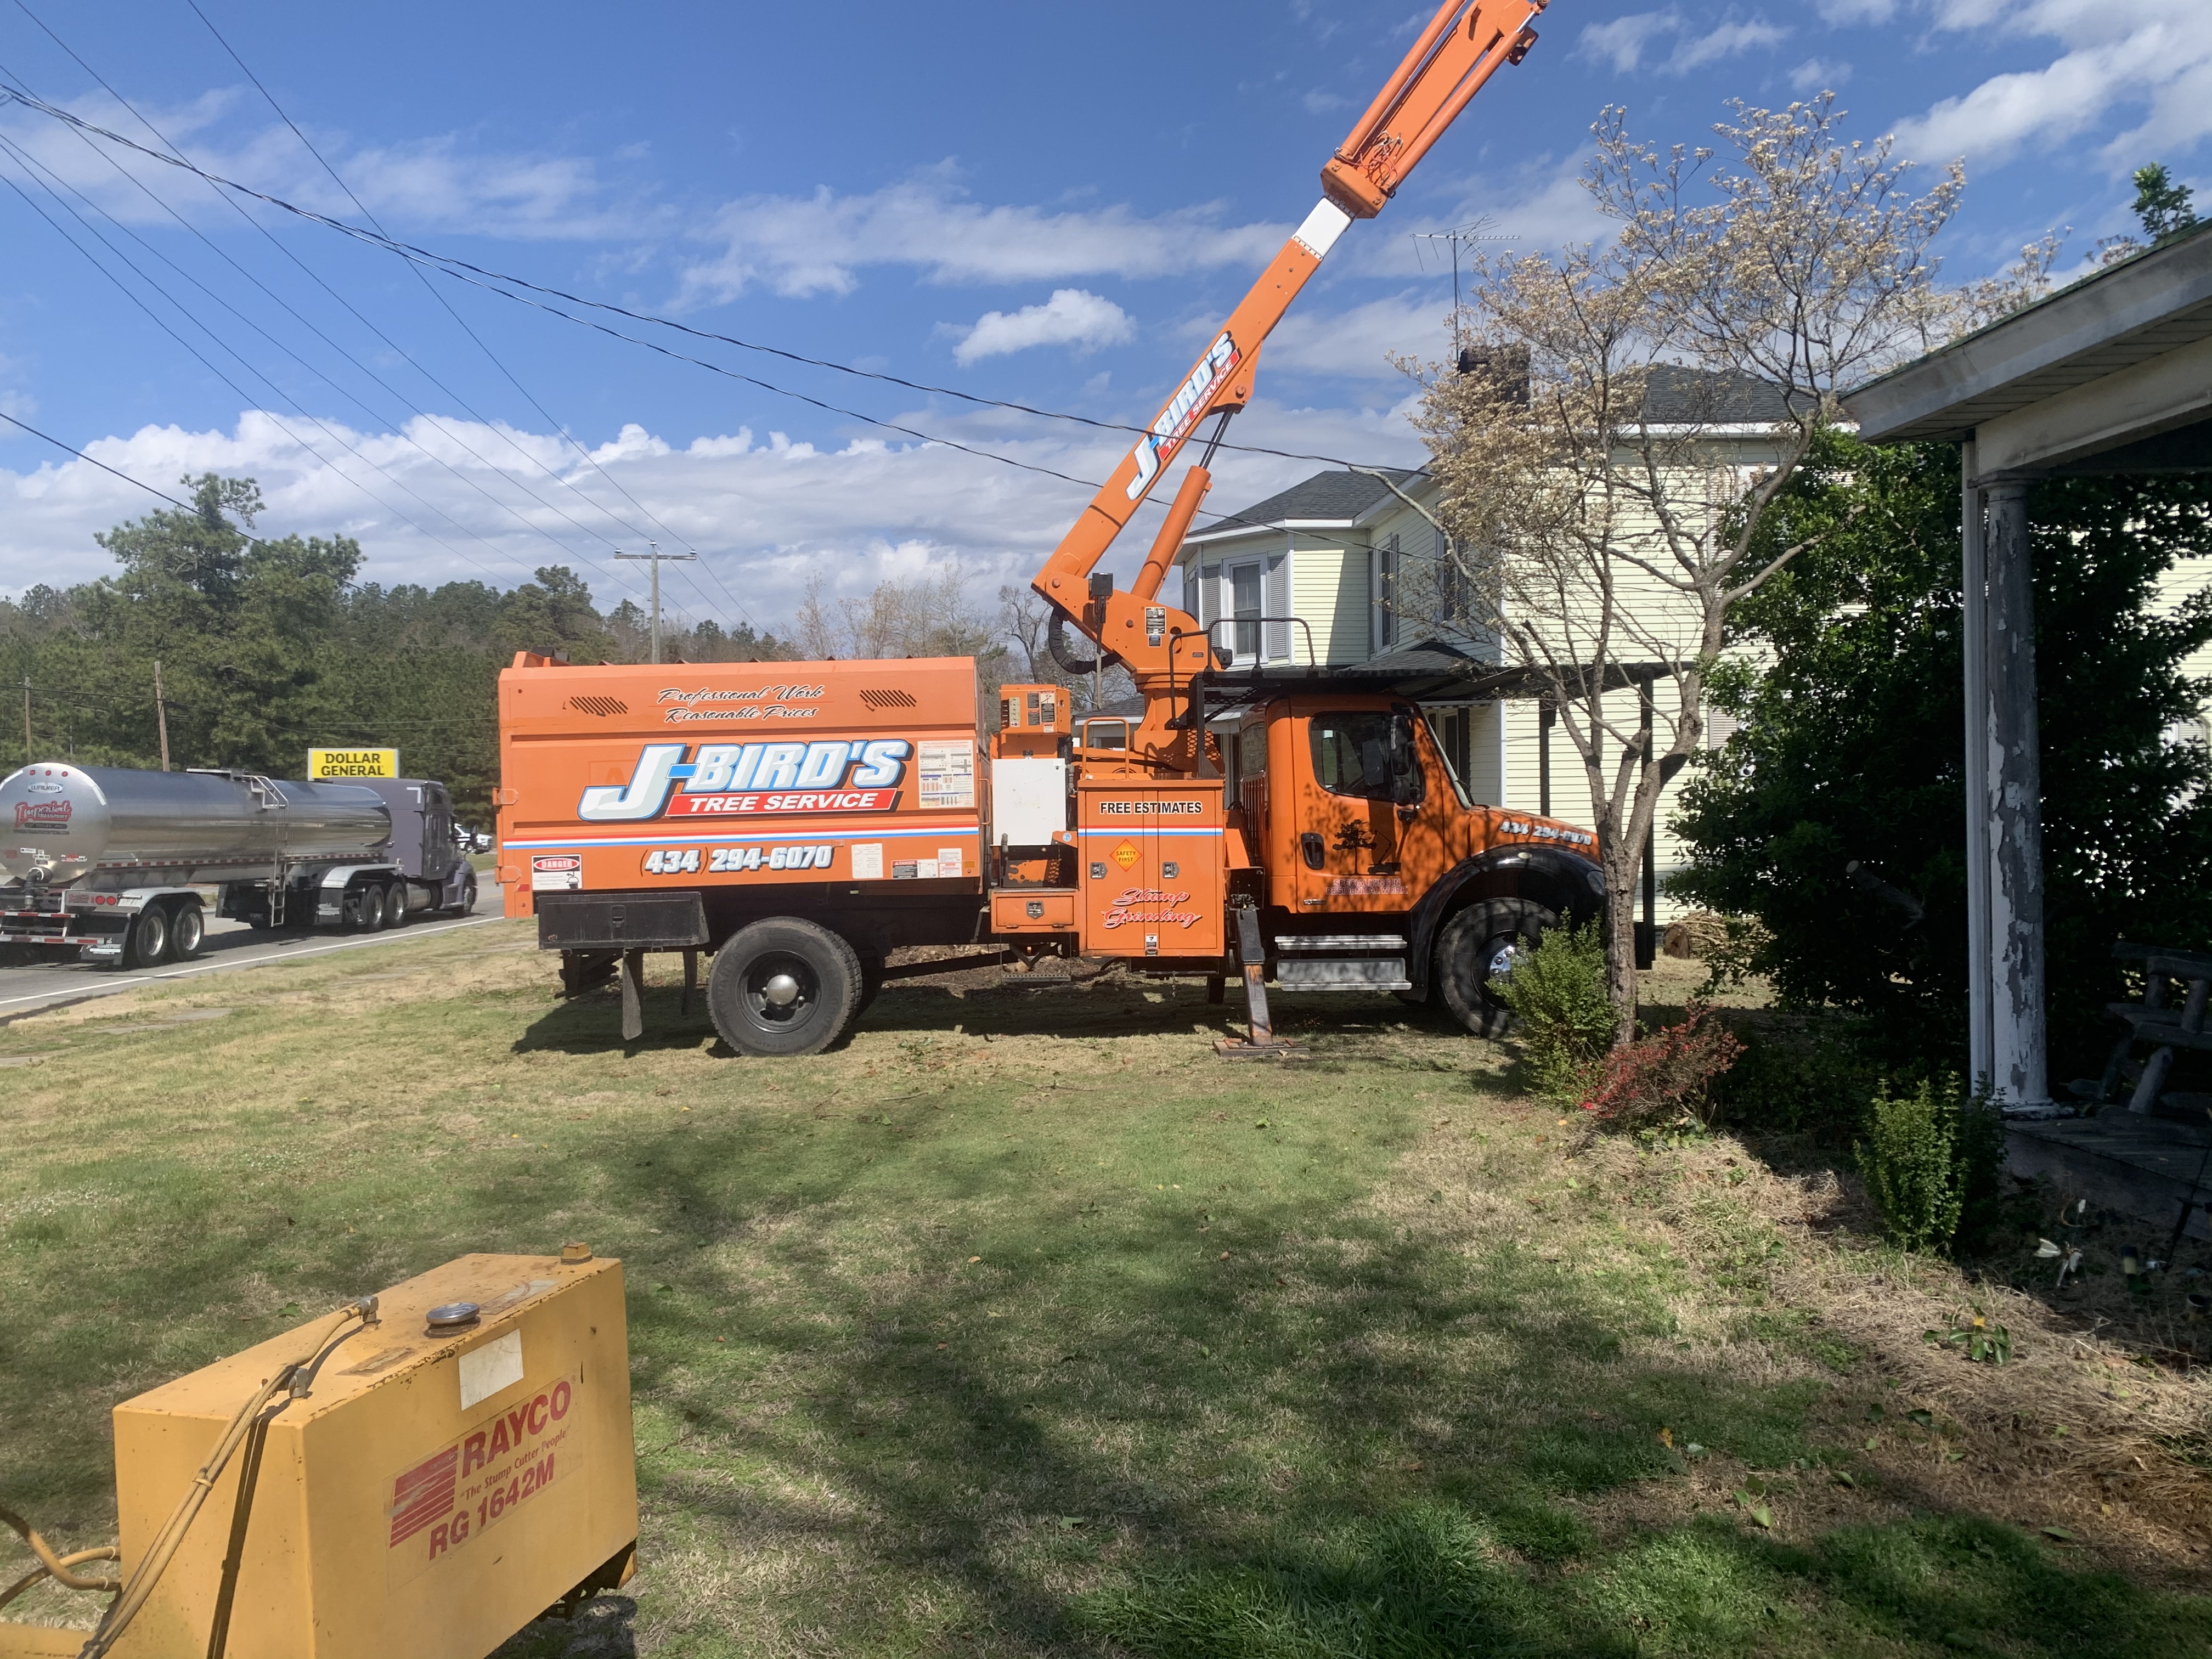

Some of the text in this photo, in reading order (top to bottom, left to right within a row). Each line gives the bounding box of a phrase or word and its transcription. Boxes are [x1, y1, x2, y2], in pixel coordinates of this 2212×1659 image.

[1165, 360, 1233, 449] TREE SERVICE
[1126, 331, 1236, 500] J-BIRD'S
[658, 685, 824, 706] Professional Work
[664, 705, 819, 724] Reasonable Prices
[325, 753, 381, 763] DOLLAR
[321, 765, 385, 776] GENERAL
[577, 739, 911, 823] J-BIRD'S
[690, 793, 879, 812] TREE SERVICE
[1100, 801, 1203, 814] FREE ESTIMATES
[1500, 821, 1529, 835] 434
[541, 860, 572, 868] DANGER
[708, 845, 834, 873] 294-6070
[1325, 886, 1408, 895] RESIDENTIAL WORK
[1333, 878, 1401, 887] SPECIALIZING IN
[1111, 888, 1190, 908] Stump
[1101, 907, 1203, 929] Grinding
[462, 1380, 571, 1479] RAYCO
[484, 1465, 512, 1489] Stump
[515, 1447, 539, 1469] Cutter
[429, 1453, 555, 1561] RG 1642M
